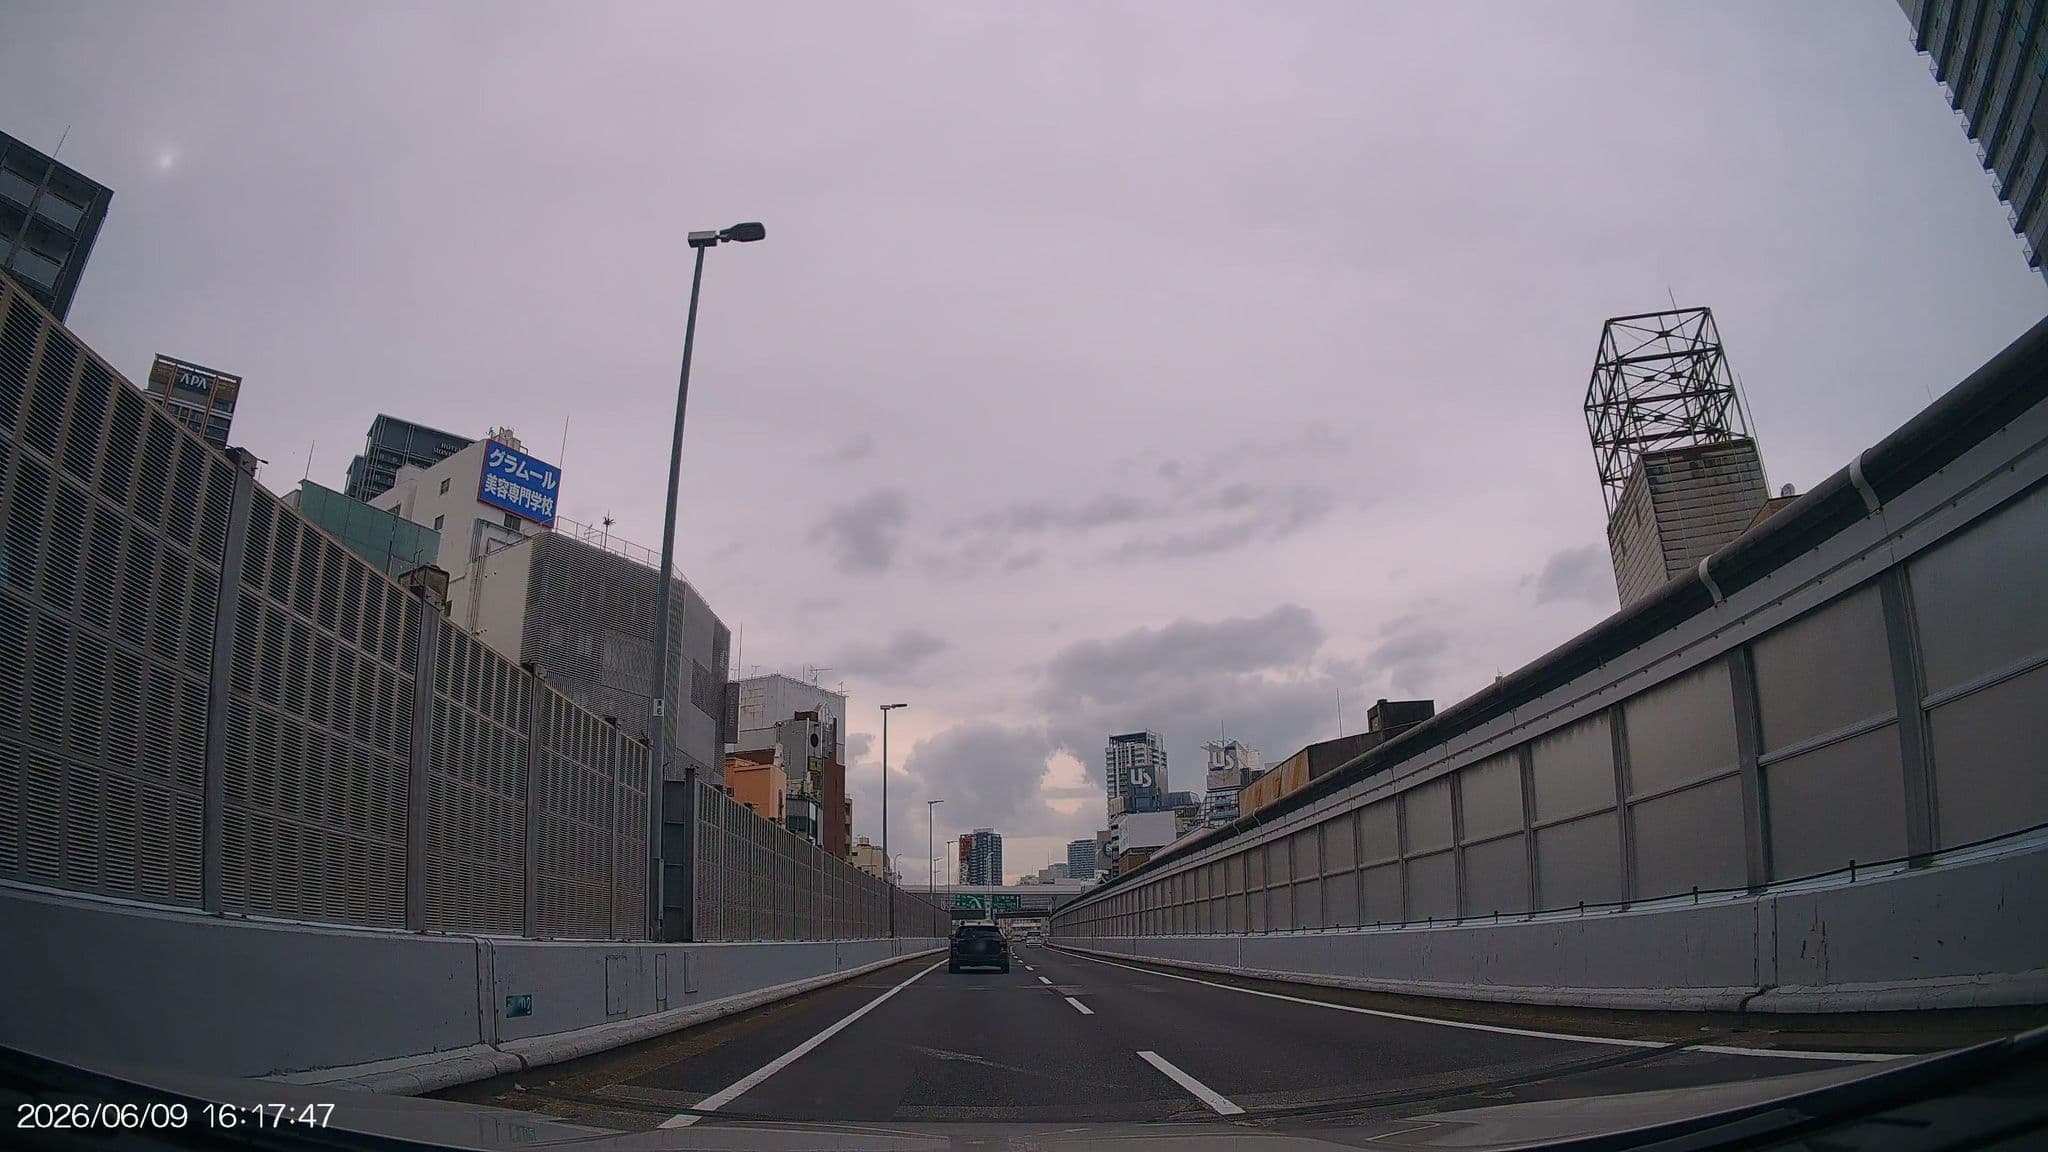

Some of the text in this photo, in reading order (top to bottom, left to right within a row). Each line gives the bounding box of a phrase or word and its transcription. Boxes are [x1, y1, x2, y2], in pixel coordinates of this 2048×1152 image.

[180, 373, 207, 390] APA
[488, 449, 557, 490] グラムール
[484, 473, 554, 517] 美容専門学校
